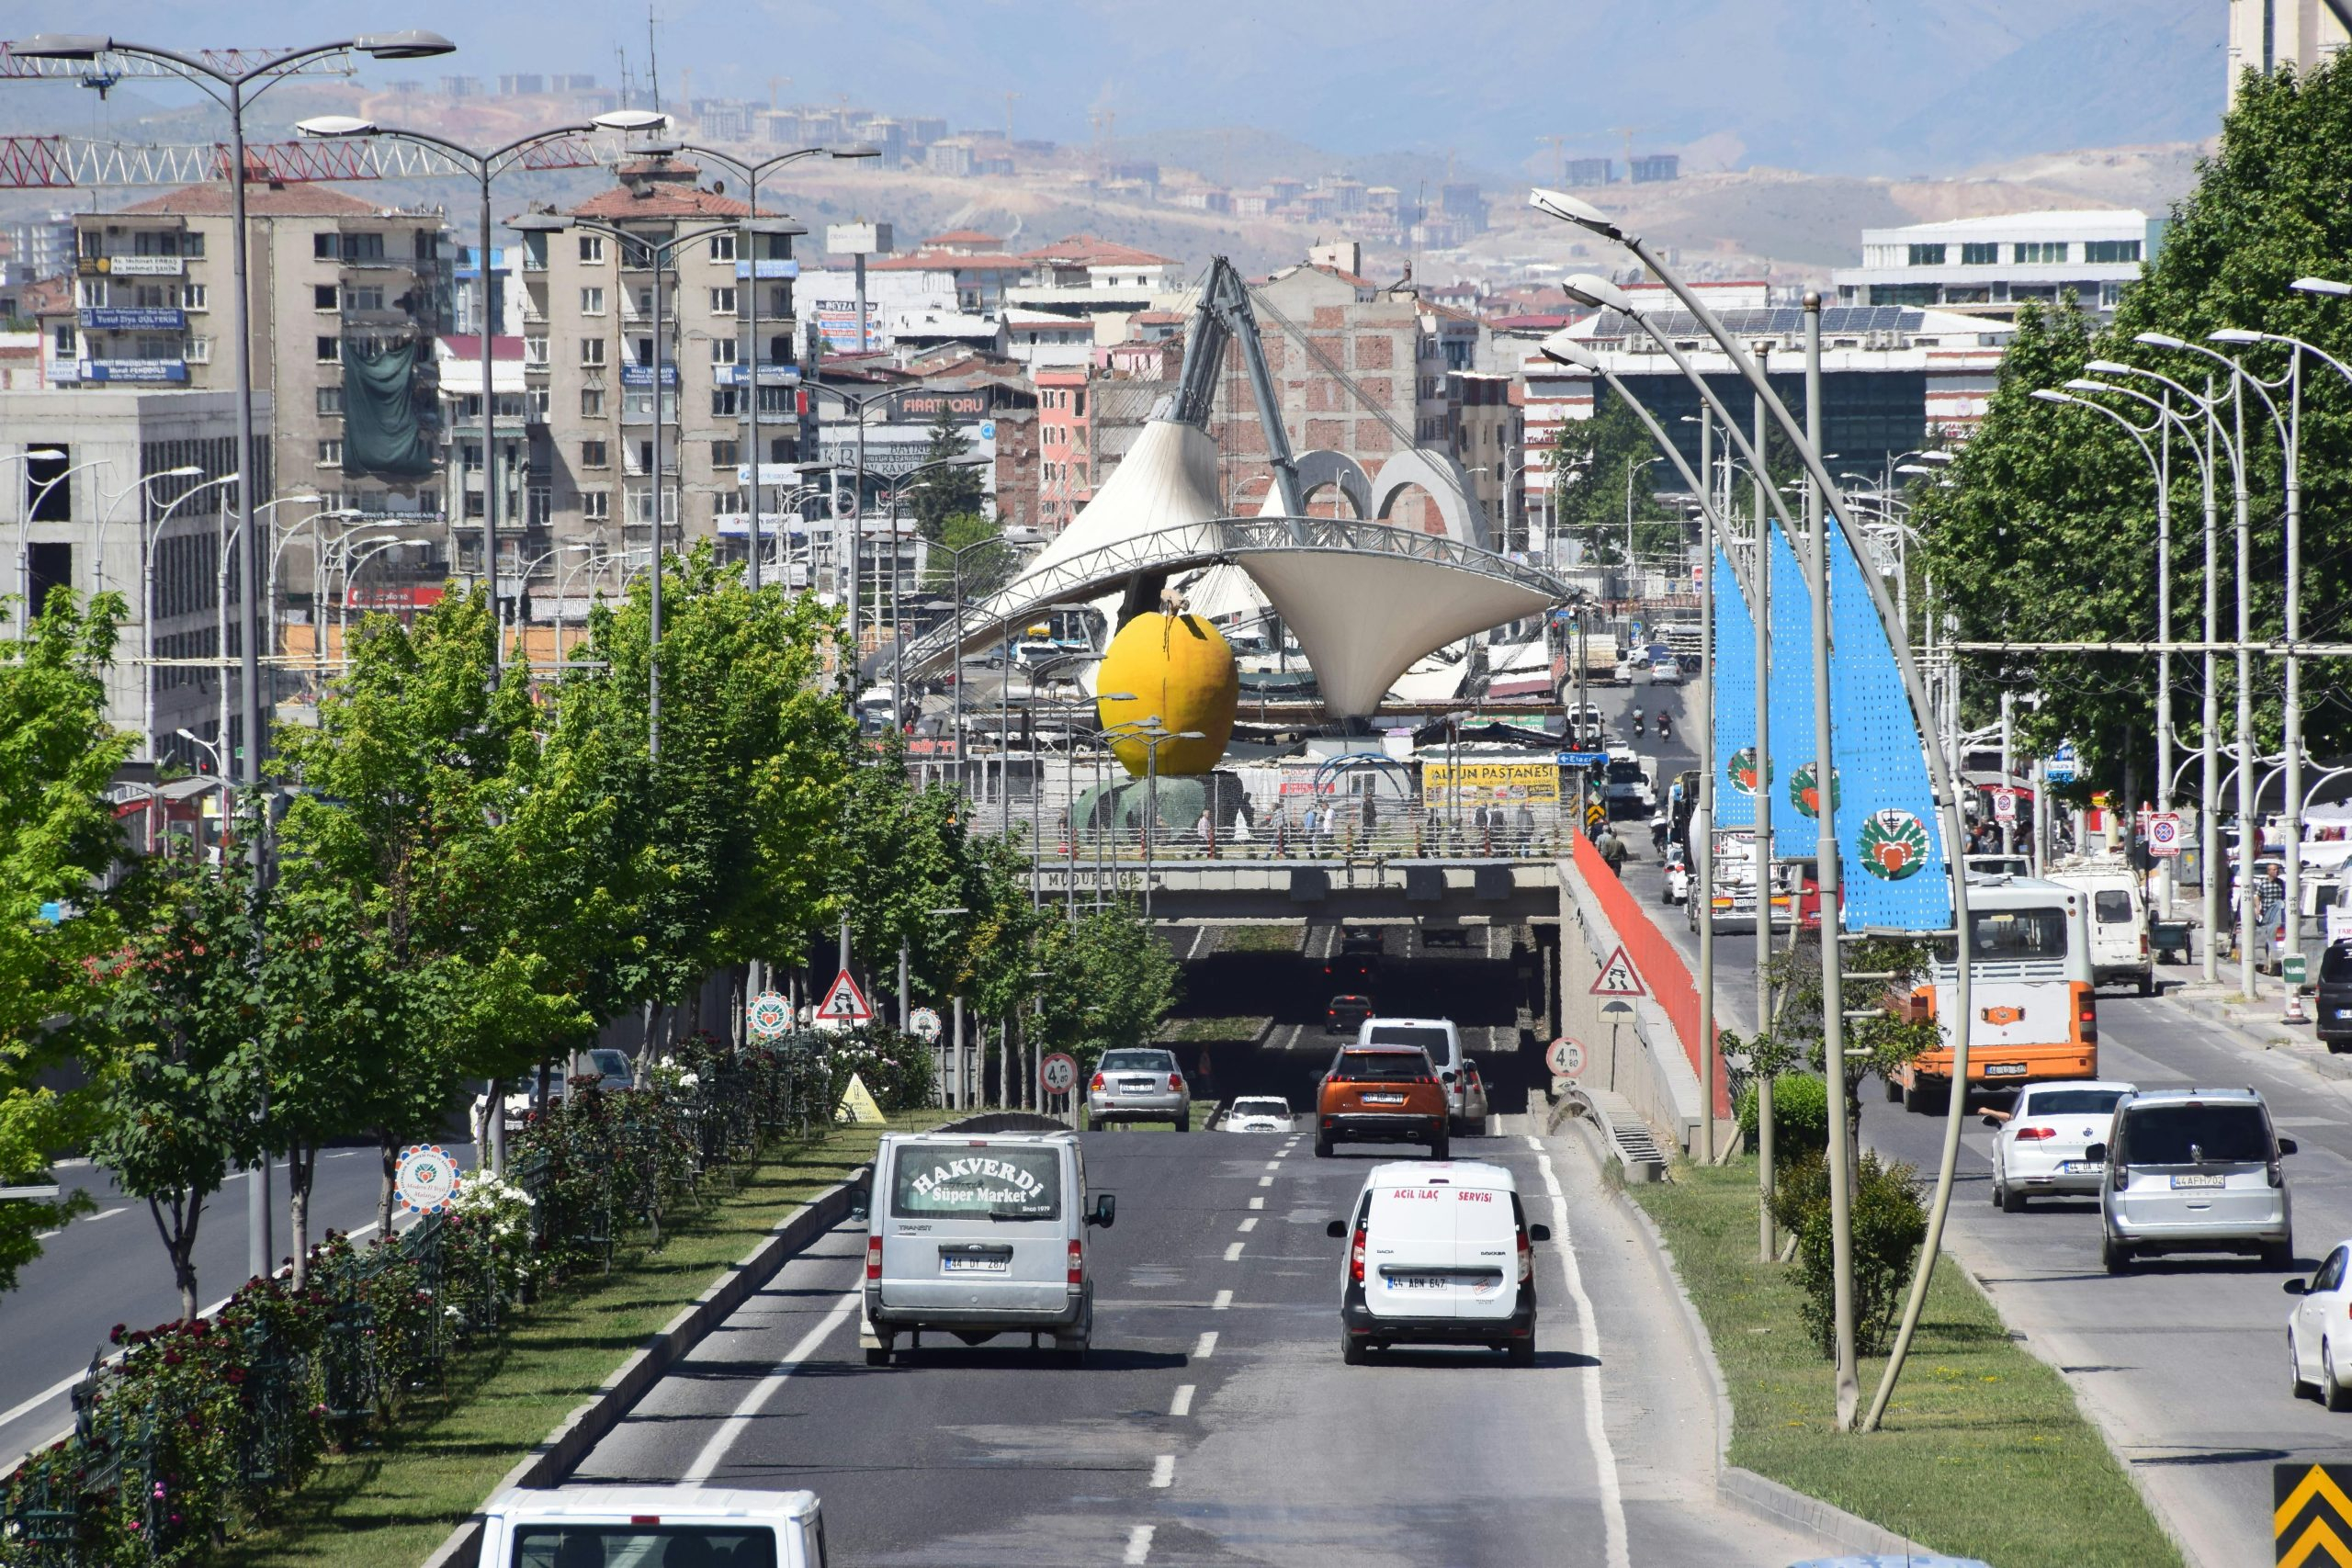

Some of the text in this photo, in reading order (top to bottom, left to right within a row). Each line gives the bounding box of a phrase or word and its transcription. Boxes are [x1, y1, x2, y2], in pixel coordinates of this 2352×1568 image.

[933, 1187, 1026, 1204] Süper Market
[951, 1258, 962, 1269] 44
[1393, 1278, 1445, 1288] 44 ABN 647
